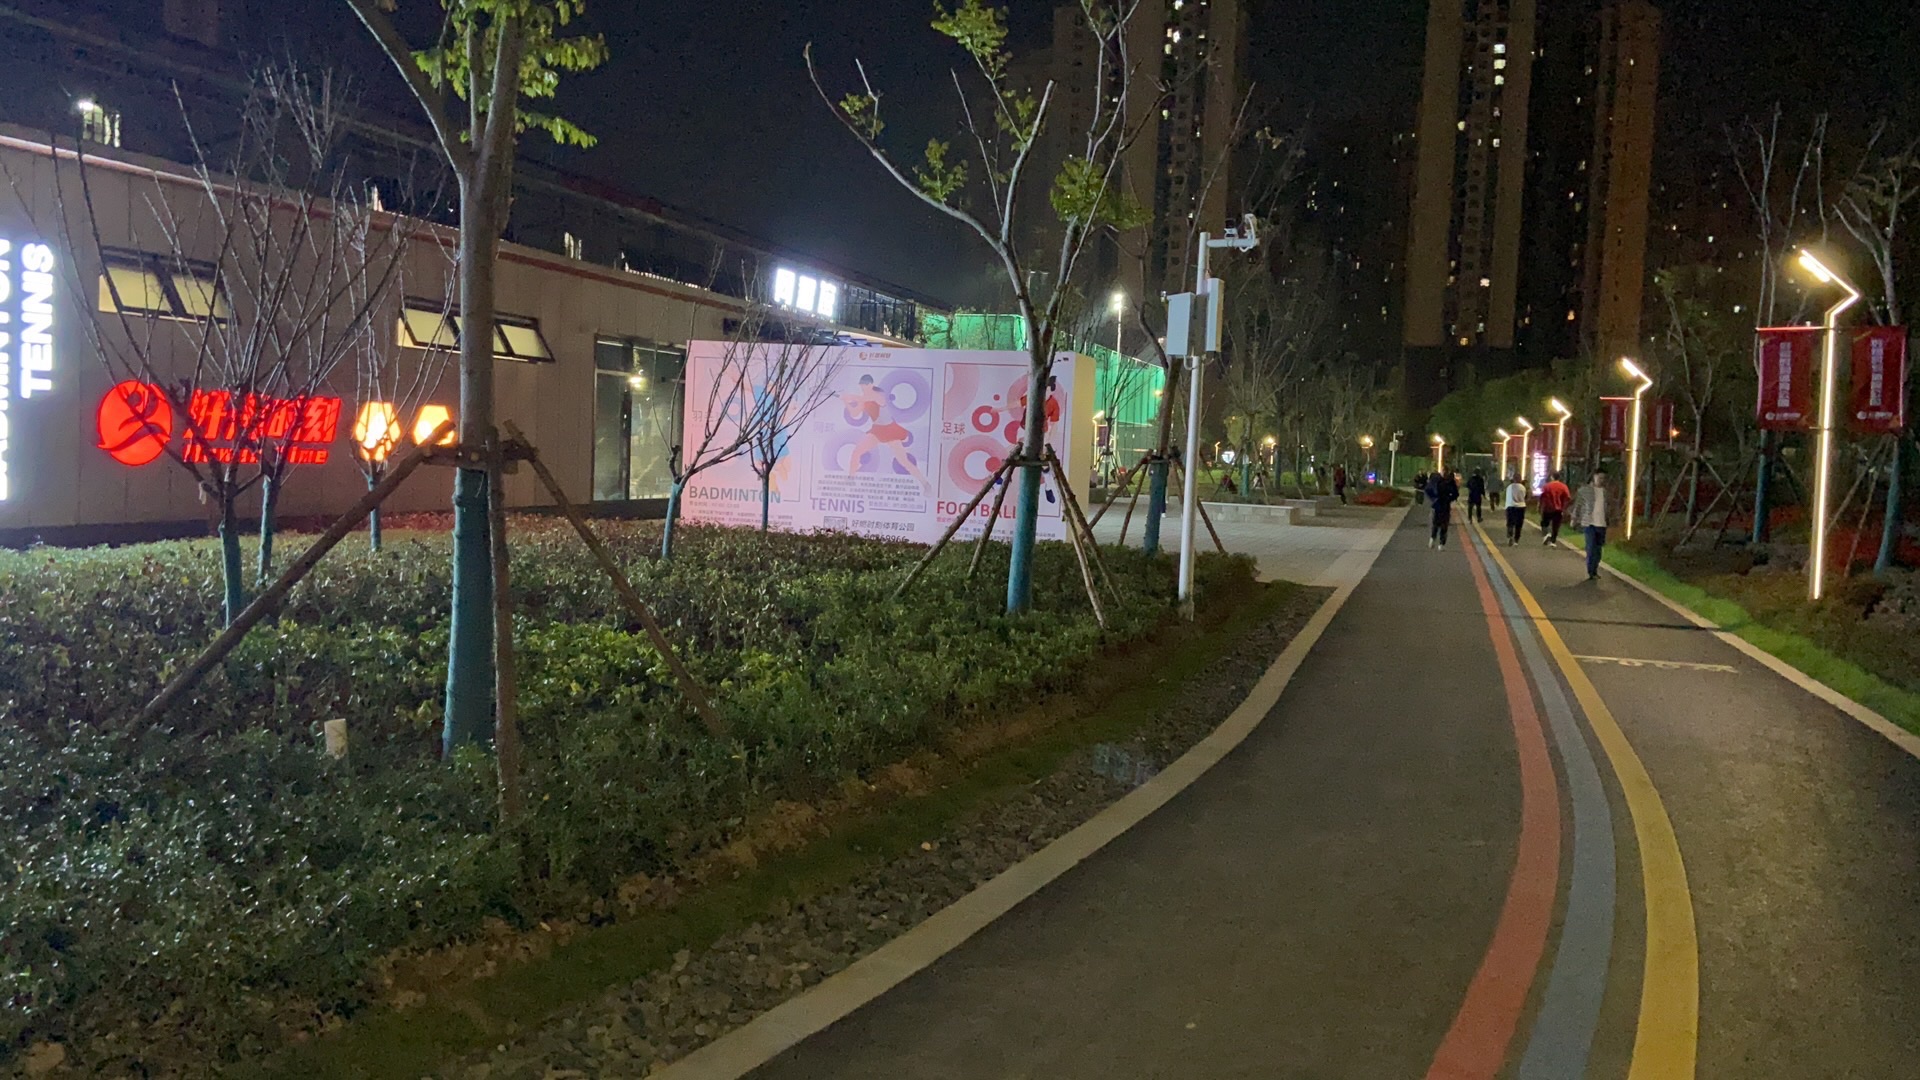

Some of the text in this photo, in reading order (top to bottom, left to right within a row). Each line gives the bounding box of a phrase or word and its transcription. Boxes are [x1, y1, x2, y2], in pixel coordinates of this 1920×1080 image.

[21, 243, 53, 399] TENNIS
[941, 422, 966, 435] 足球
[811, 498, 865, 514] TENNIS
[936, 501, 1017, 519] FOOTBLL
